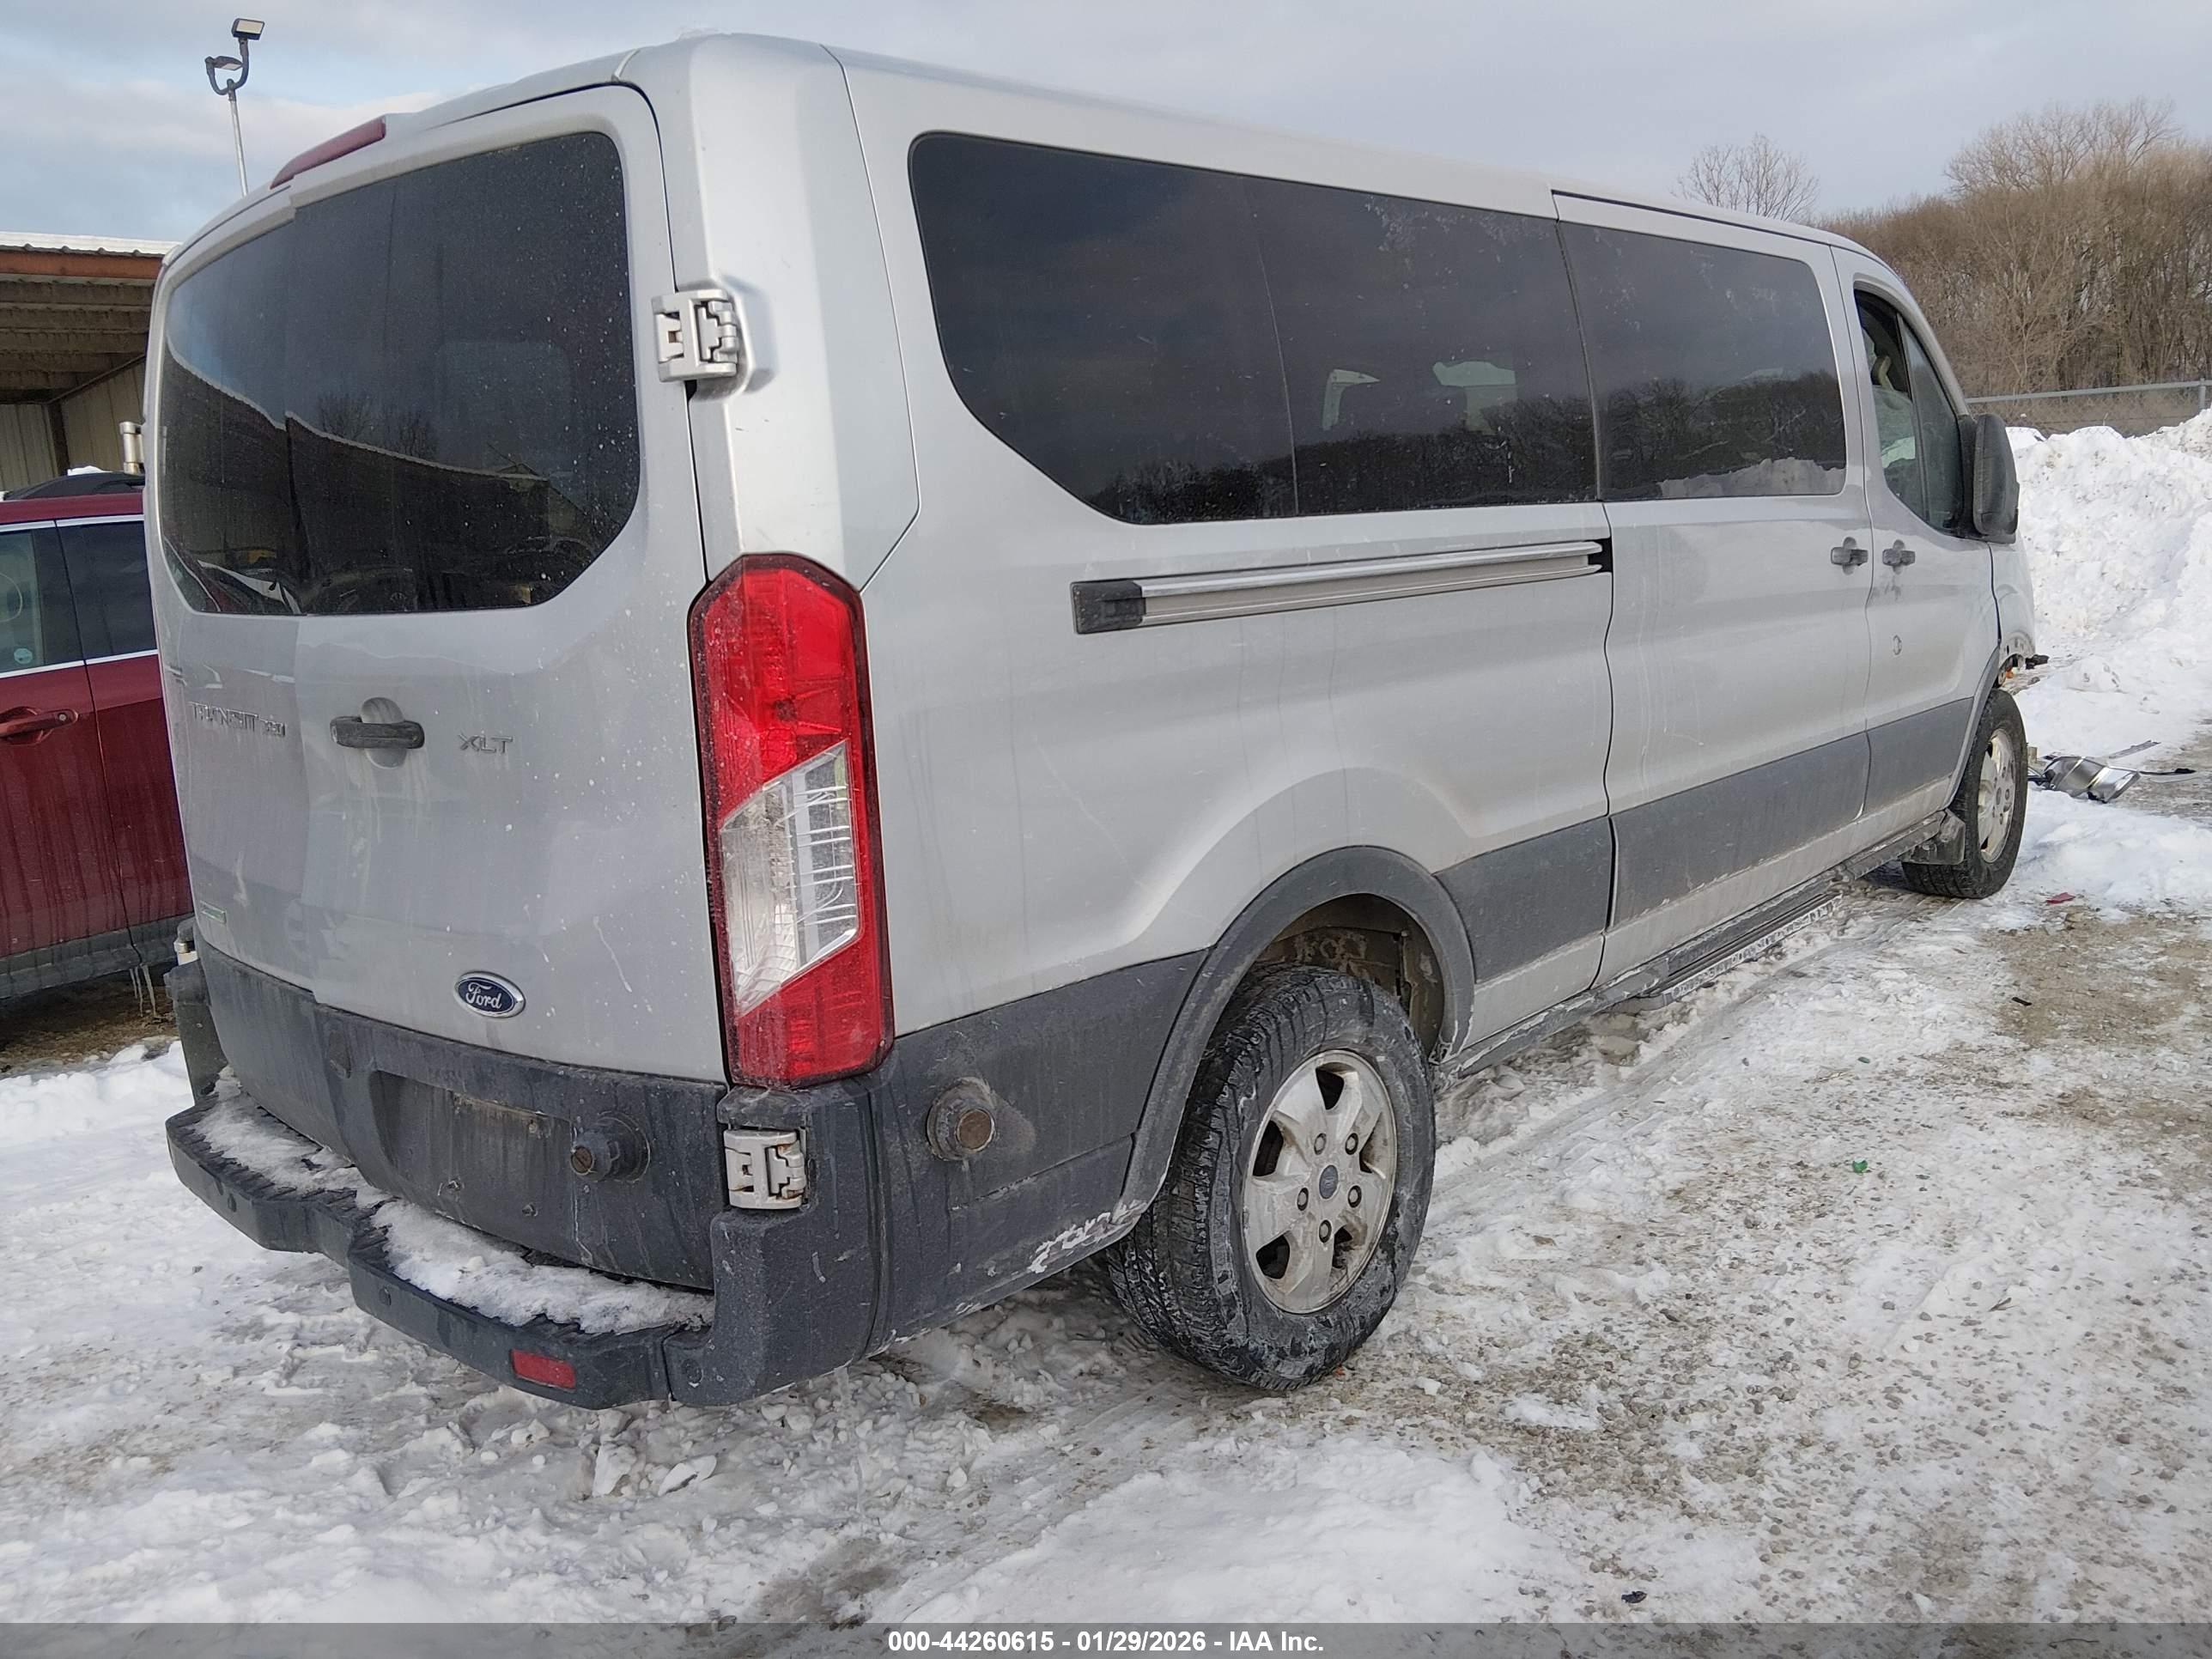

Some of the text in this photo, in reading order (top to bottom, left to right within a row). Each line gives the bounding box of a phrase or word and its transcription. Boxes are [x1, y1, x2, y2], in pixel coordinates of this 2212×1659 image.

[188, 701, 259, 732] TRANSIT
[458, 733, 514, 754] XLT
[465, 981, 502, 1009] Ford
